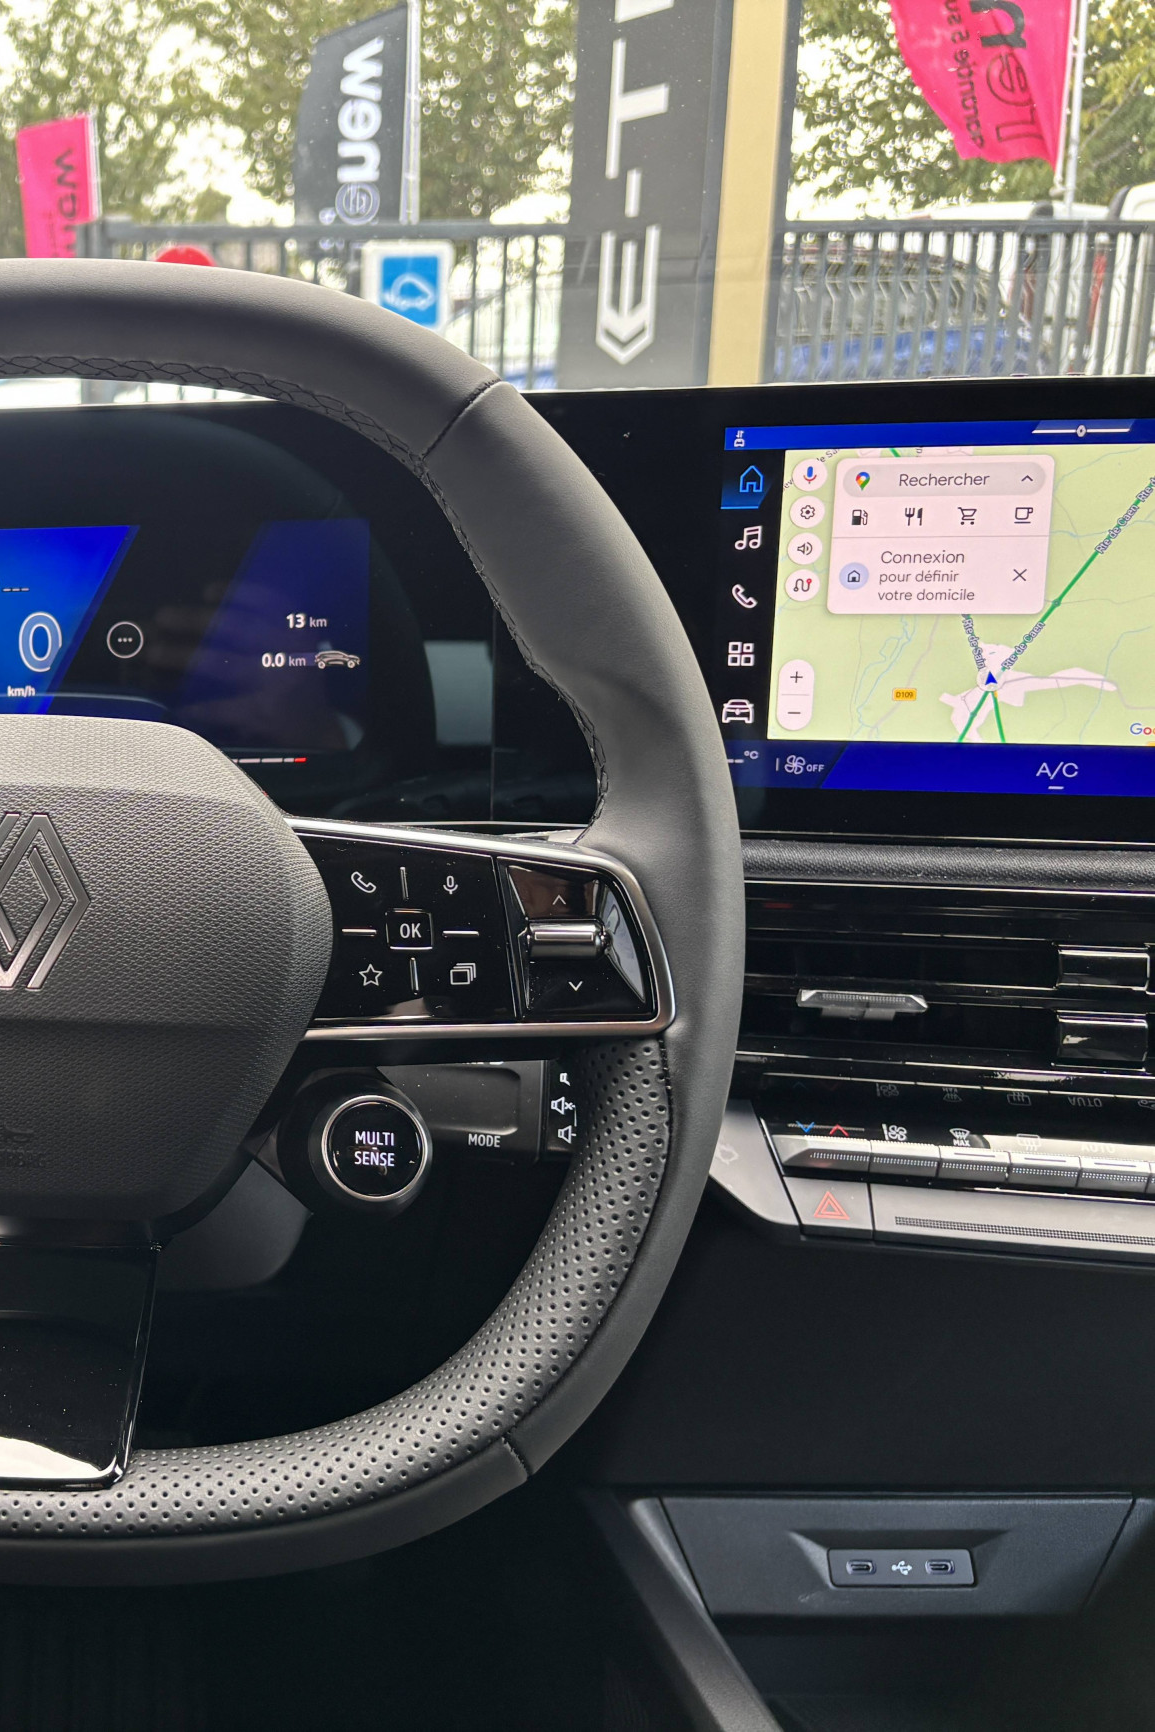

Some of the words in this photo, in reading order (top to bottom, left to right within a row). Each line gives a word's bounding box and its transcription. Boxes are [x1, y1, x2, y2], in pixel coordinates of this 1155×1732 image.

[596, 0, 675, 365] E-T
[898, 472, 990, 487] Rechercher
[1108, 527, 1122, 539] de
[1117, 504, 1140, 526] Caen
[880, 550, 965, 564] Connexion
[879, 572, 911, 584] pour
[915, 570, 959, 583] définir
[878, 590, 913, 601] votre
[917, 589, 975, 601] domicile
[286, 613, 306, 629] 13
[309, 616, 328, 628] km
[18, 611, 62, 673] 0
[1014, 642, 1027, 655] de
[1023, 621, 1046, 643] Caen
[261, 652, 286, 668] 0.0
[288, 655, 306, 667] km
[7, 685, 36, 698] km/h
[895, 690, 914, 698] D109
[1129, 722, 1155, 736] Go
[806, 764, 825, 772] OFF
[1036, 763, 1079, 779] A/C
[399, 923, 421, 938] OK
[355, 1131, 395, 1146] MULTI
[468, 1133, 501, 1148] MODE
[953, 1139, 971, 1147] MAX
[354, 1151, 395, 1167] SENSE
